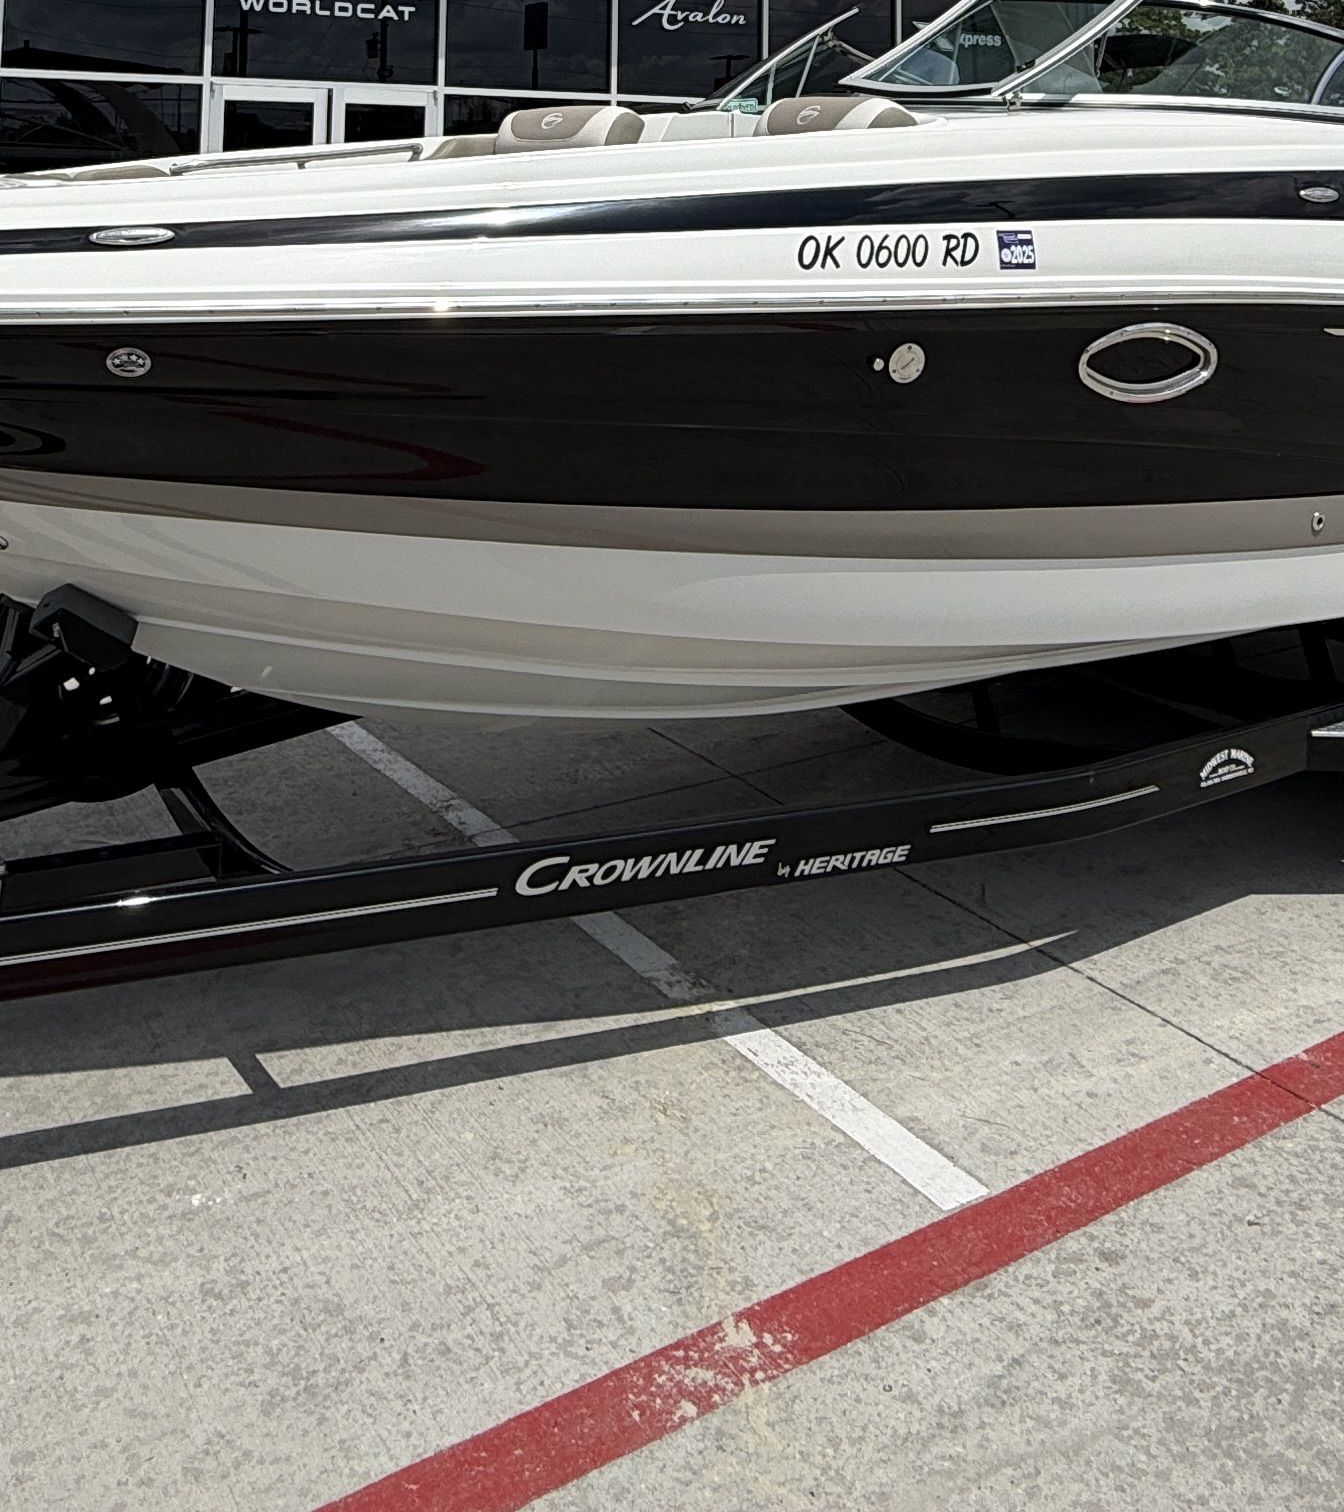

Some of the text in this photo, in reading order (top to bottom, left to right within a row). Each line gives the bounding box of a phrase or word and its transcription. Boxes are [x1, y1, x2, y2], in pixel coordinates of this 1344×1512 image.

[797, 232, 980, 270] OK 0600 RD
[1010, 244, 1035, 264] 2025
[515, 838, 777, 896] CROWNLINE
[794, 844, 912, 877] HERITAGE
